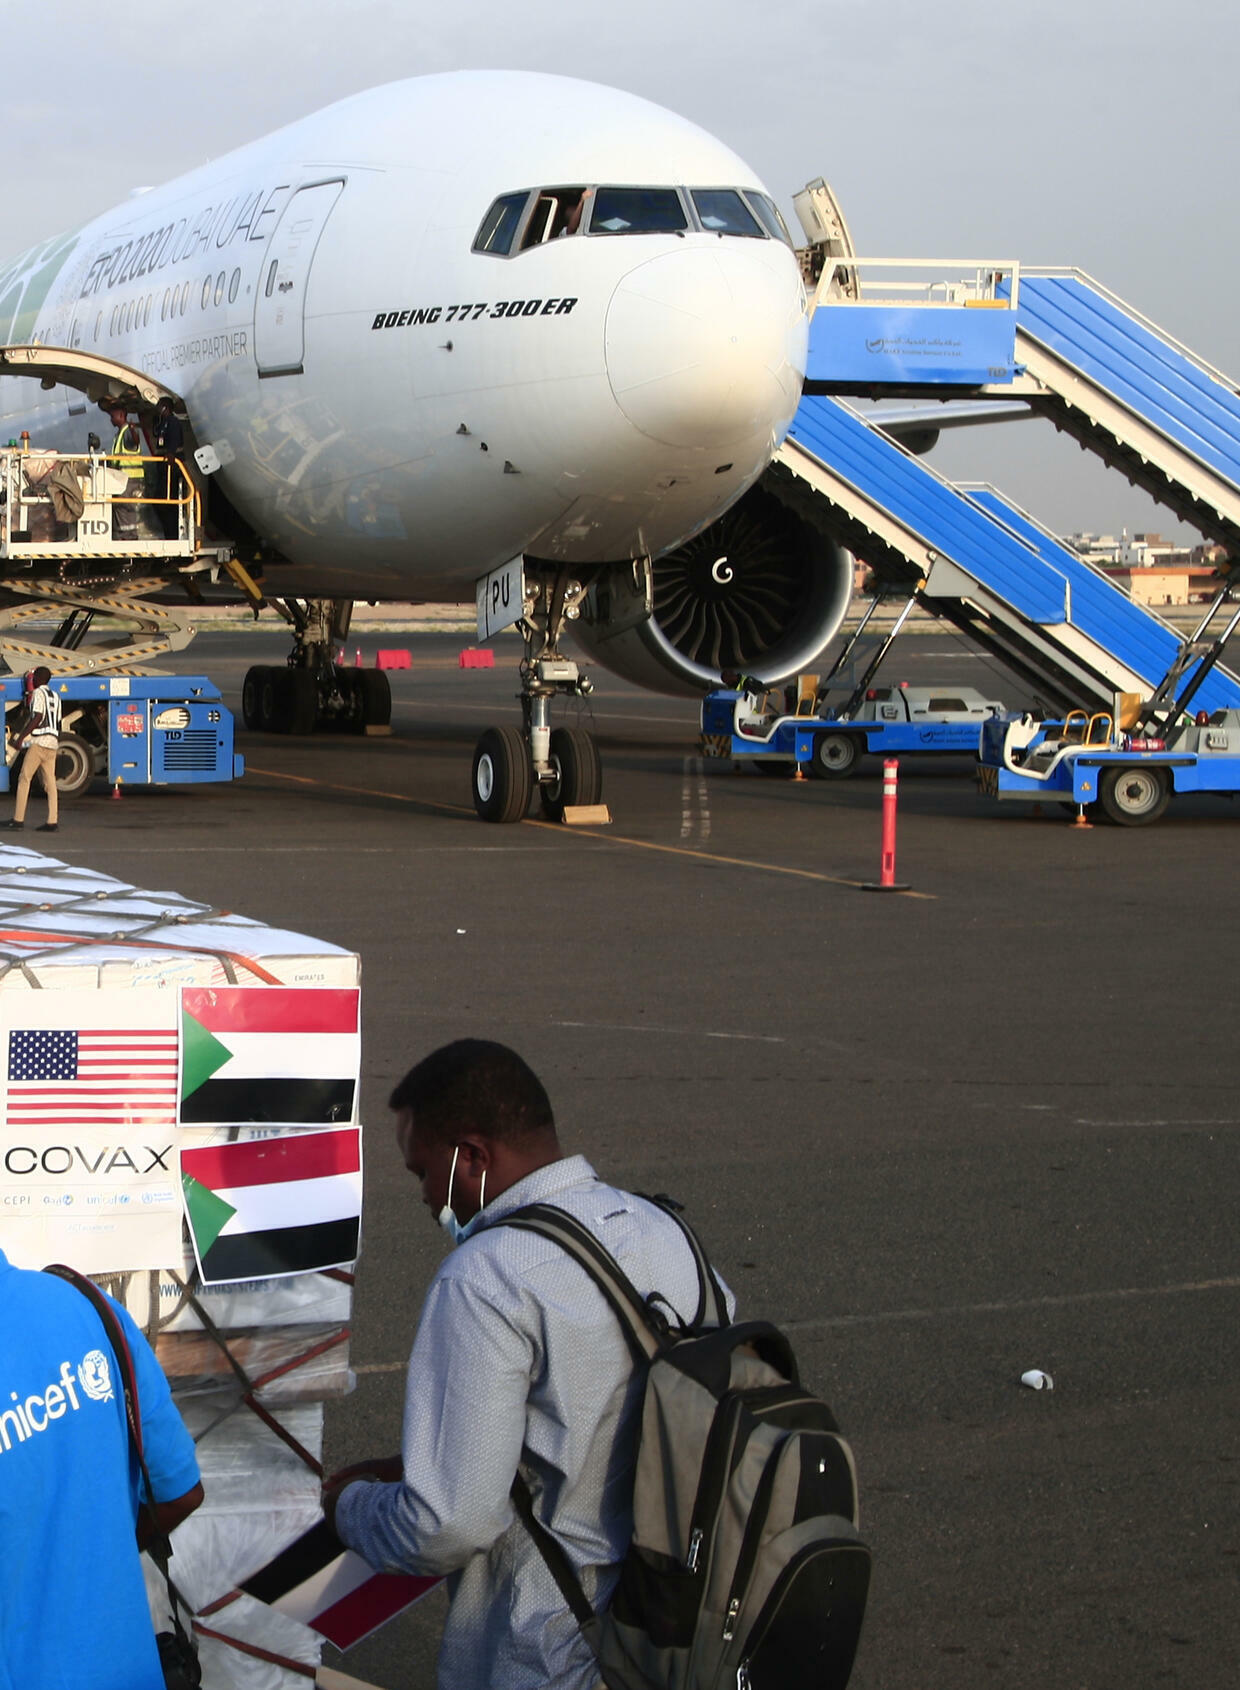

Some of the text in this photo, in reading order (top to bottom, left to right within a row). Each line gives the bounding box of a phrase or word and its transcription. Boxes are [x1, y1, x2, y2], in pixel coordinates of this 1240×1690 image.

[371, 307, 442, 330] BOEING
[203, 332, 247, 361] PARTNER
[80, 519, 109, 536] TLD
[493, 572, 510, 615] PU
[165, 731, 181, 740] TLD
[4, 1144, 174, 1175] COVAX
[4, 1196, 31, 1205] CEPI
